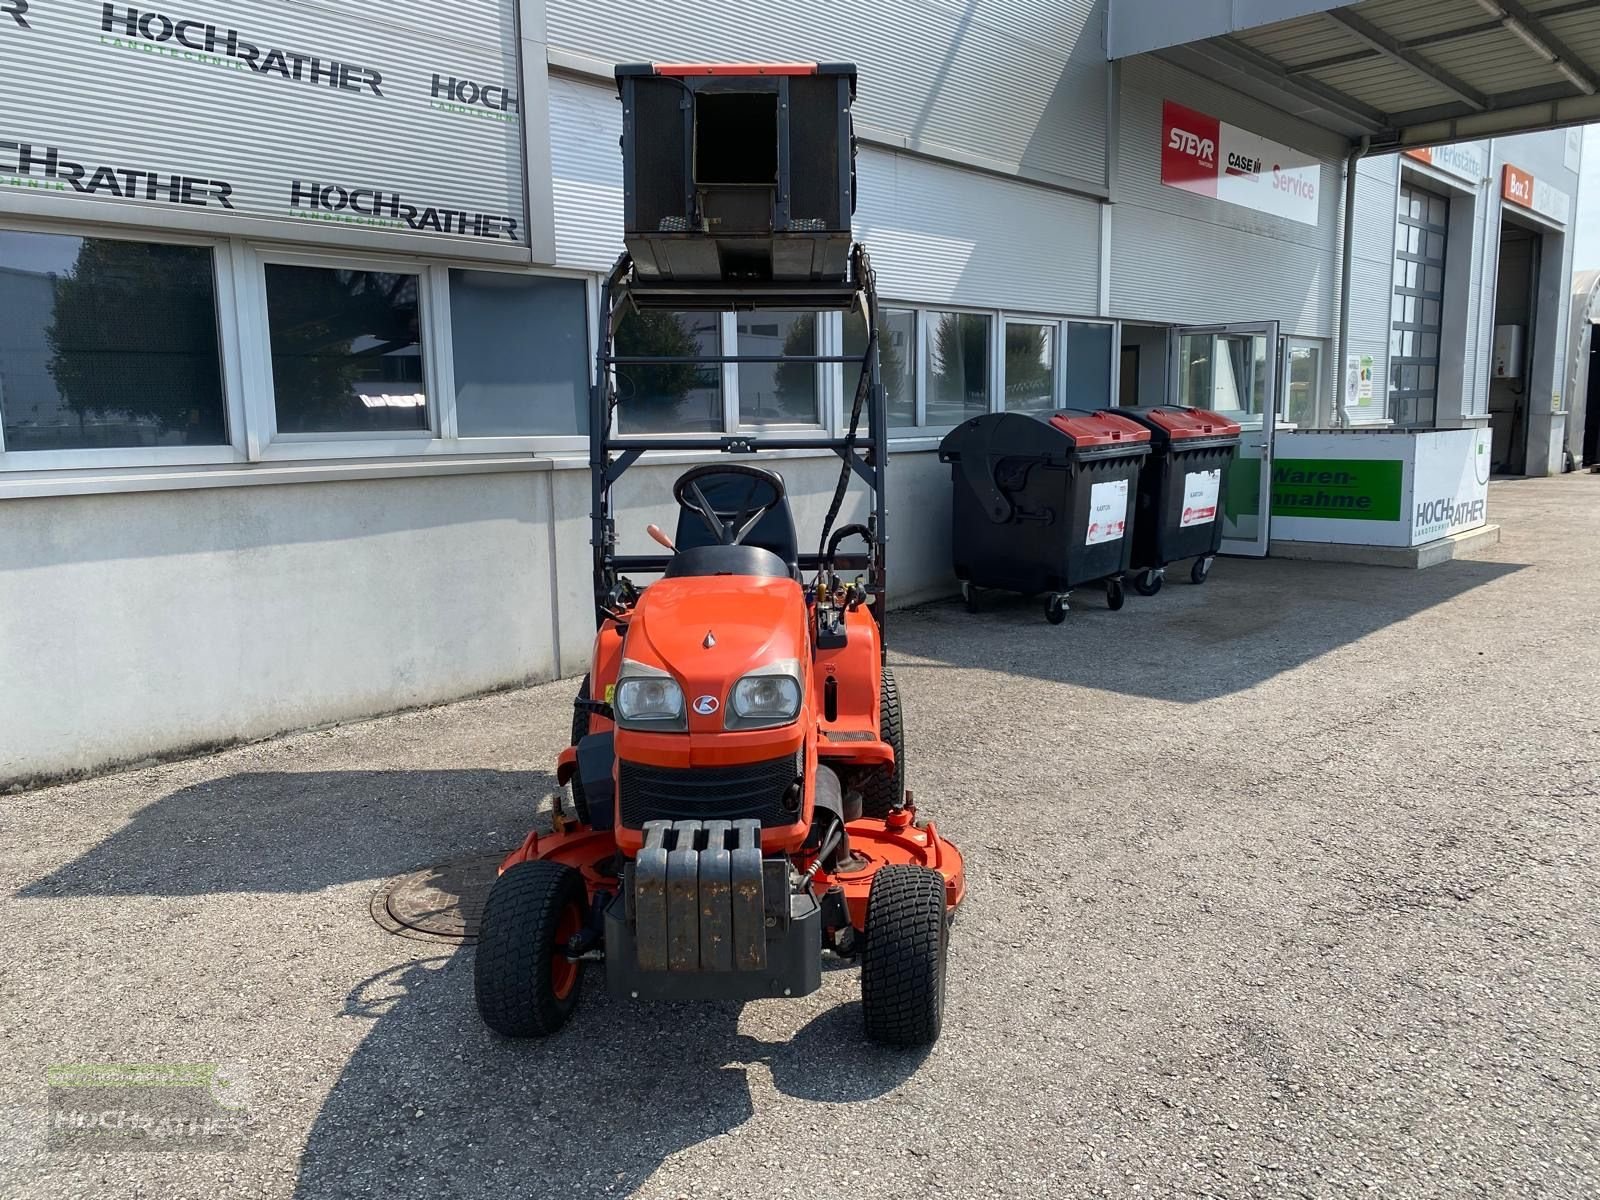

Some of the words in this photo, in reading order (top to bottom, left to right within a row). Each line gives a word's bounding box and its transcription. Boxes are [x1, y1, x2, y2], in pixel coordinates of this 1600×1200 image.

[100, 35, 244, 71] LANDTECHNIK
[101, 2, 384, 97] HOCHRATHER
[1168, 127, 1215, 162] STEYR
[1228, 152, 1253, 172] CASE
[1272, 163, 1315, 200] Service
[1510, 173, 1524, 197] Box
[1524, 181, 1529, 199] 2
[289, 209, 404, 228] LANDTECHNIK
[290, 180, 518, 240] HOCHRATHER
[1415, 498, 1484, 527] HOCHRATHER
